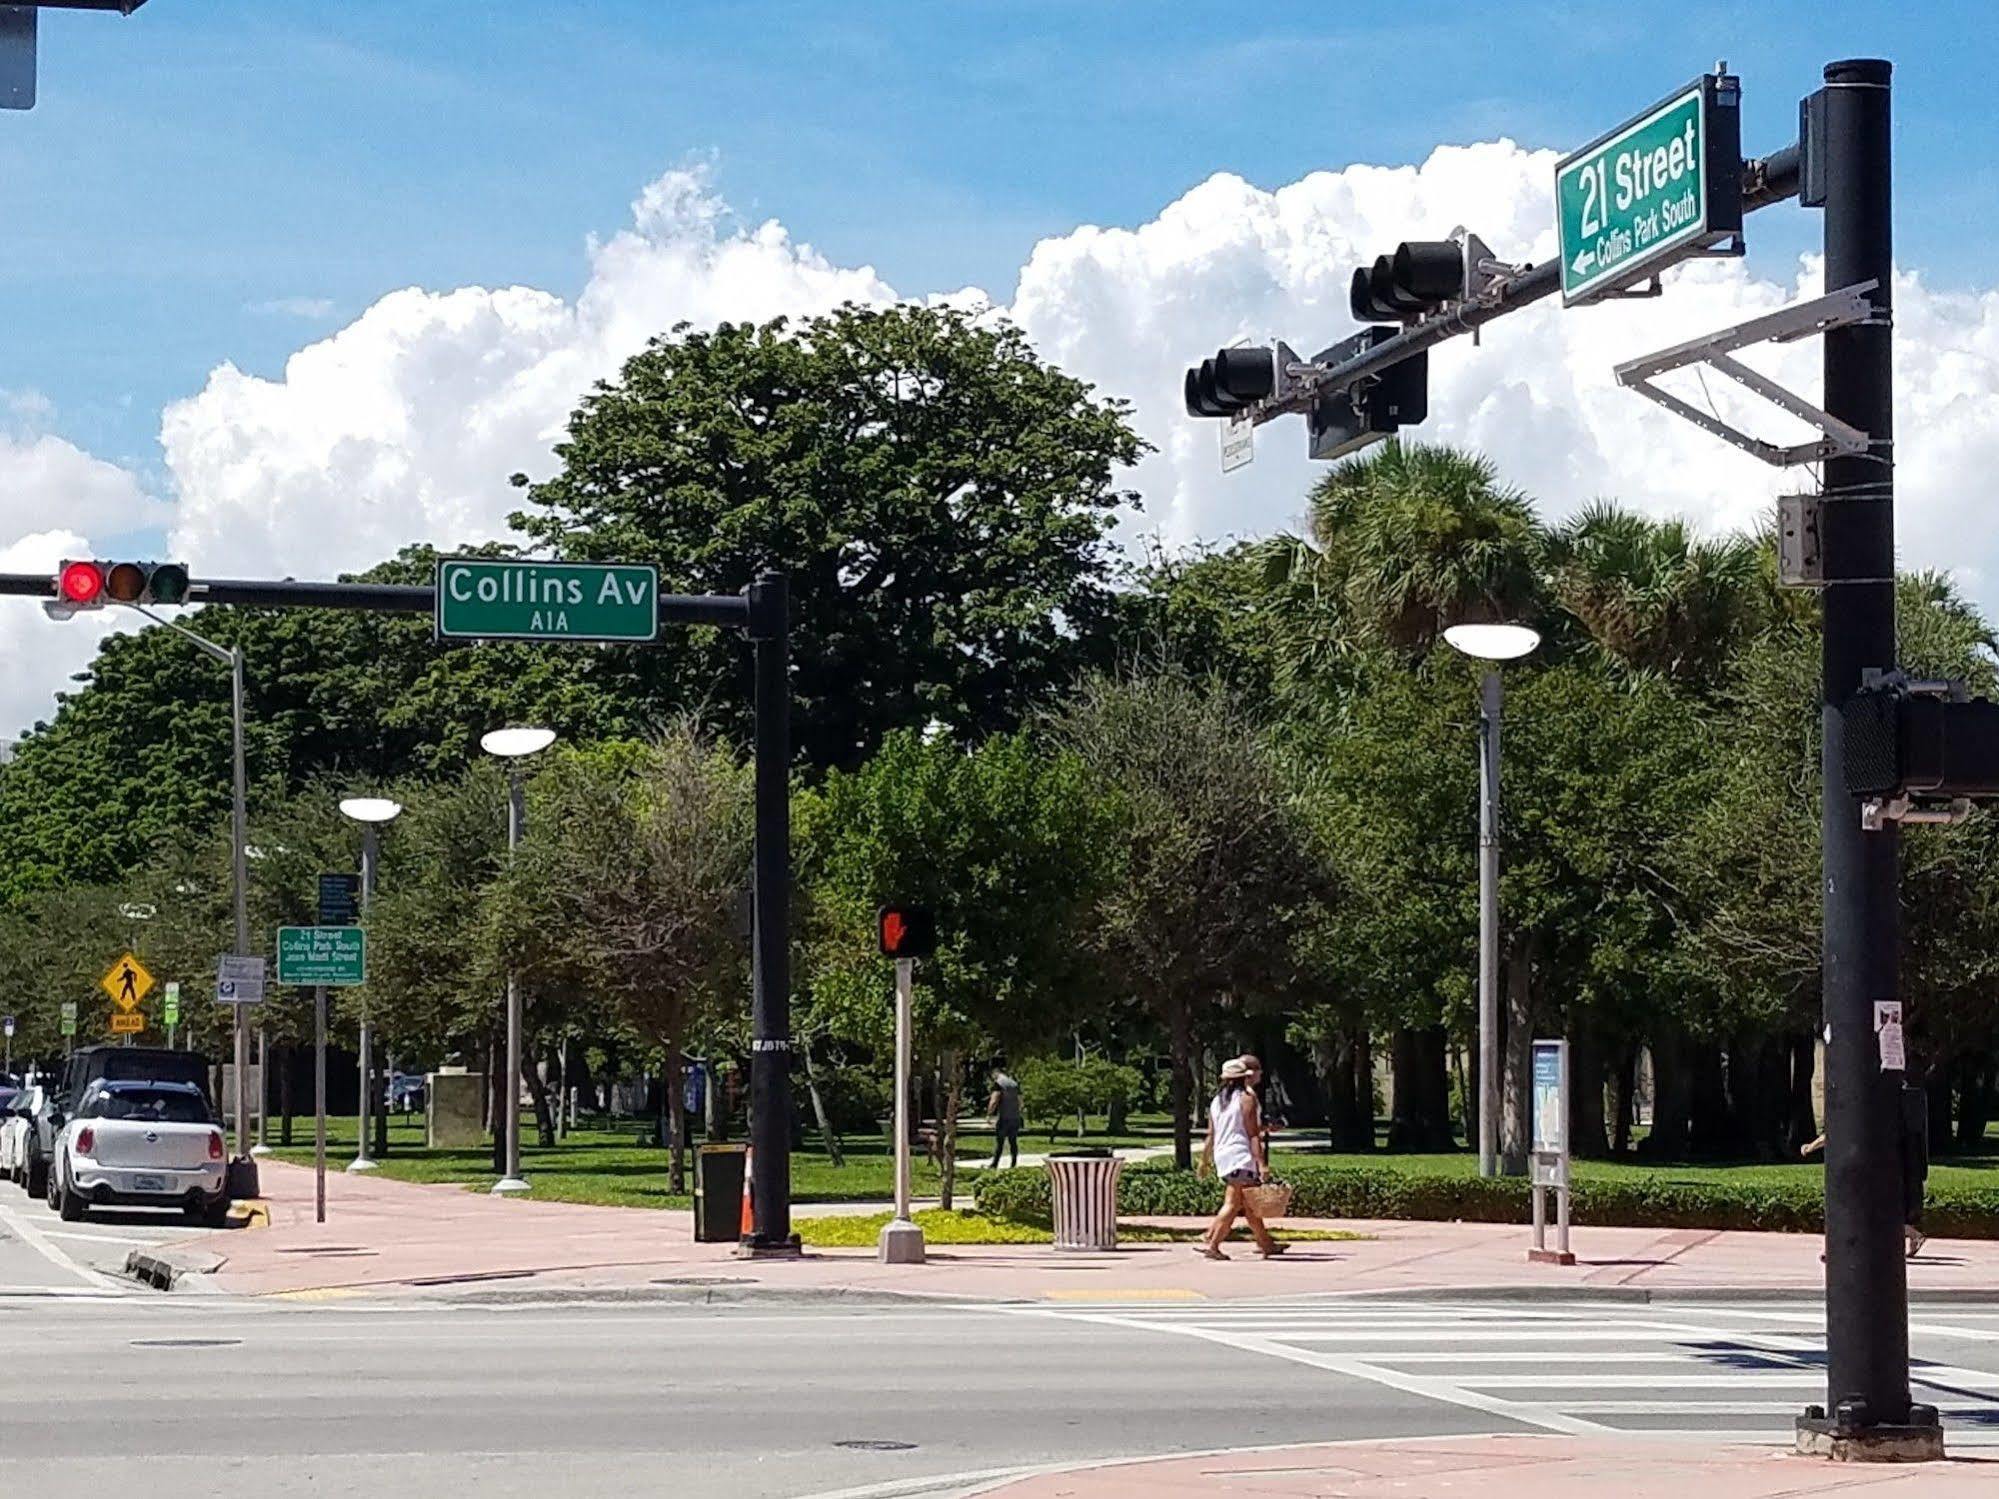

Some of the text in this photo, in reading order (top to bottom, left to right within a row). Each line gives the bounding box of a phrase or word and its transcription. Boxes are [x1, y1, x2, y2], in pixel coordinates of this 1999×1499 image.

[1578, 118, 1696, 240] 21 Street
[1596, 187, 1696, 267] Collins Park South
[450, 567, 648, 606] Collins Av
[530, 610, 568, 632] A1A
[313, 930, 343, 940] Street
[313, 940, 332, 951] Park
